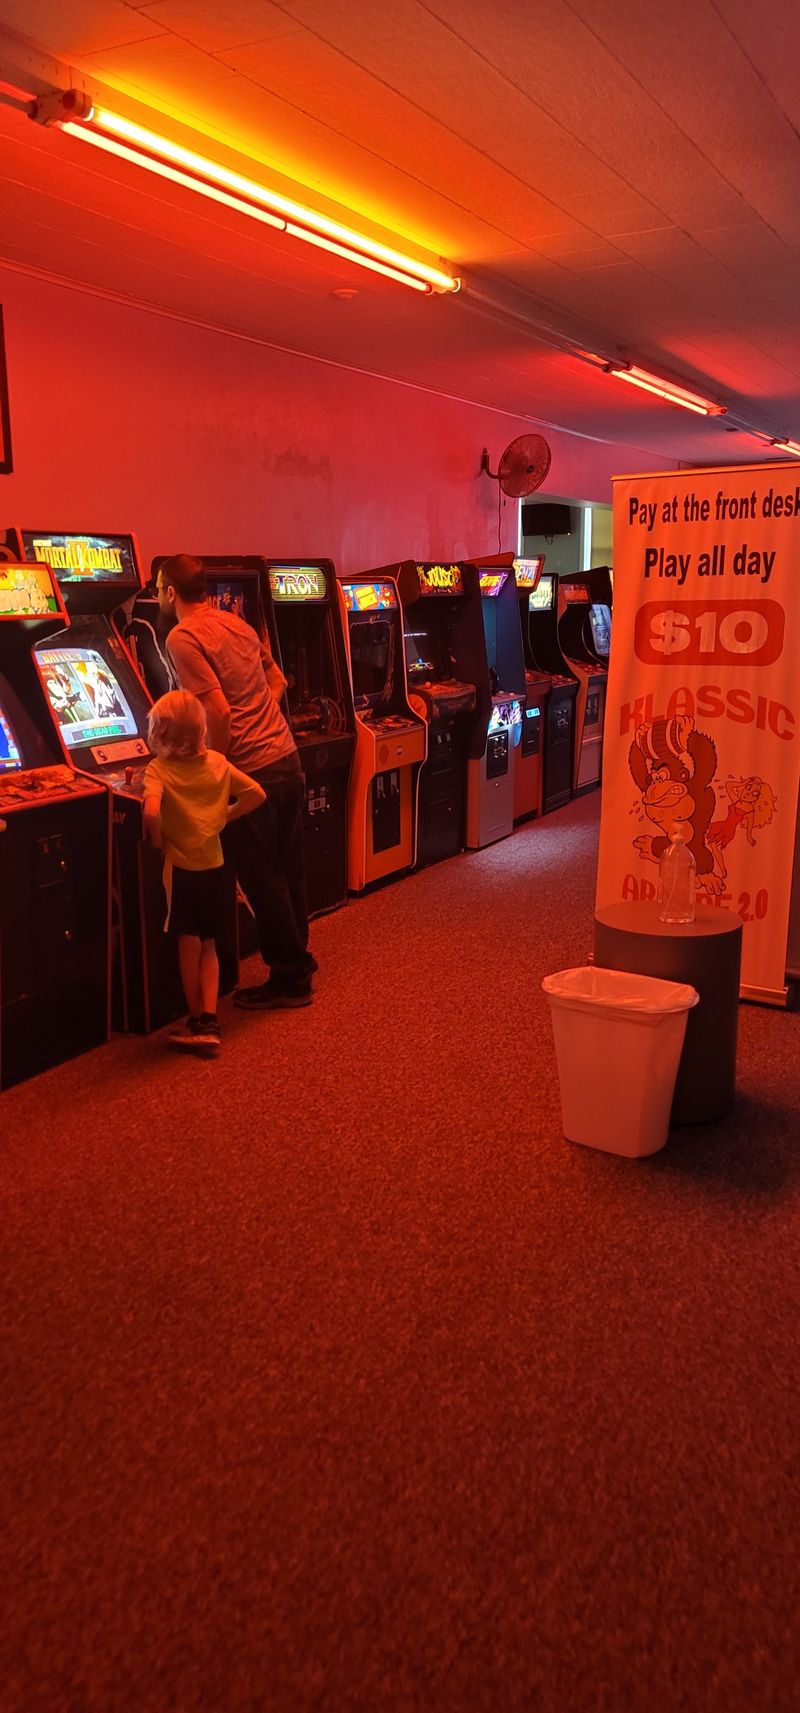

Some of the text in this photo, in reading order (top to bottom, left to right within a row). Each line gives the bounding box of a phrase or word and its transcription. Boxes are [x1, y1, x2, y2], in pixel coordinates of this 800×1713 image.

[629, 497, 657, 531] Pay
[662, 495, 678, 522] at
[684, 493, 710, 522] the
[715, 490, 757, 520] front
[82, 548, 123, 569] KOMBAT
[427, 565, 454, 587] JOUST
[644, 544, 776, 585] Play all day
[275, 573, 319, 595] TRON
[649, 610, 768, 655] $10
[620, 685, 795, 741] KLASSIC
[738, 889, 768, 921] 2.0
